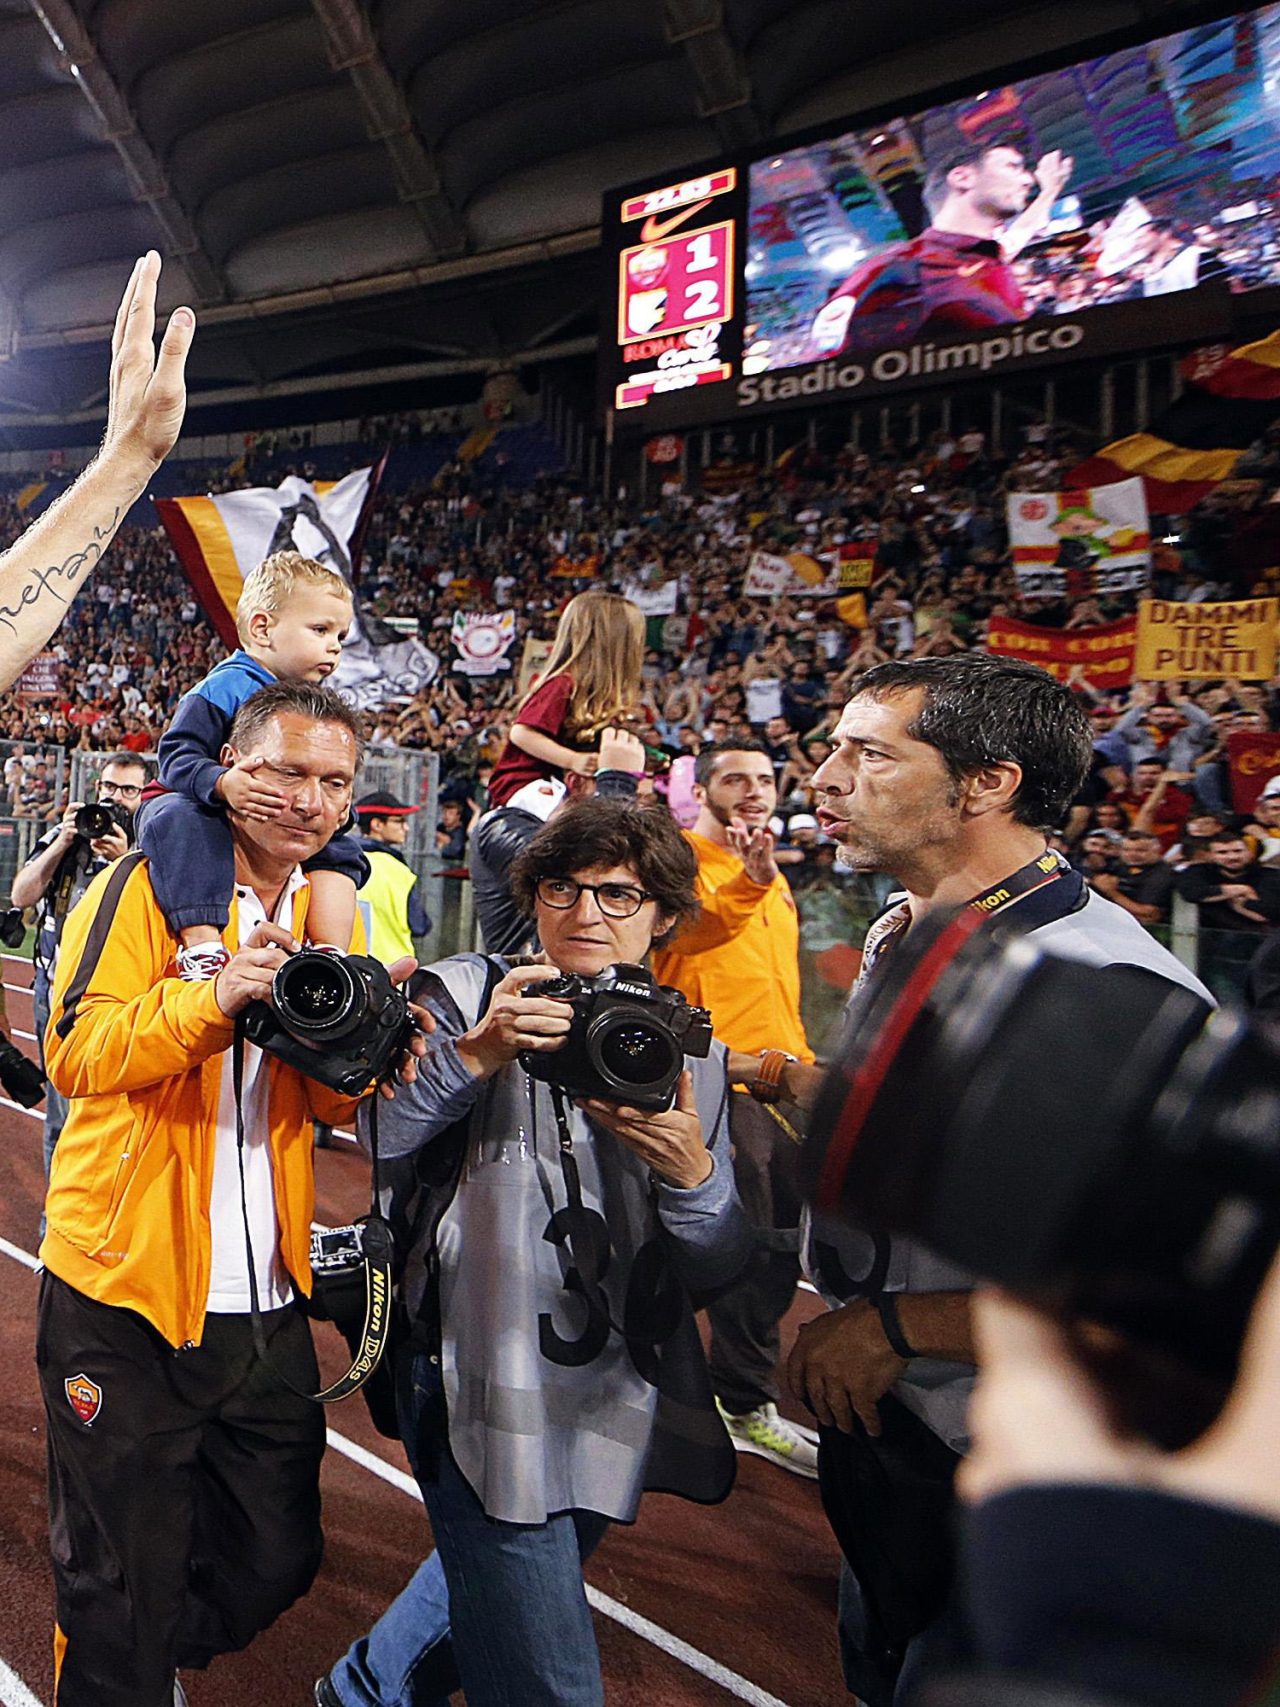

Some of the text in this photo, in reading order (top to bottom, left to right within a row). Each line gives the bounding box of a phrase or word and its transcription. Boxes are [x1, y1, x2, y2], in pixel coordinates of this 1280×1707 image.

[686, 233, 719, 274] 1
[683, 280, 720, 320] 2
[737, 363, 865, 407] Stadio
[872, 324, 1084, 382] Olimpico
[1149, 602, 1268, 623] DAMMI
[1177, 625, 1239, 648] TRE
[1155, 648, 1257, 673] PUNTI
[966, 888, 1011, 912] ikon
[615, 982, 651, 997] Nikon
[370, 1267, 385, 1332] Nikon
